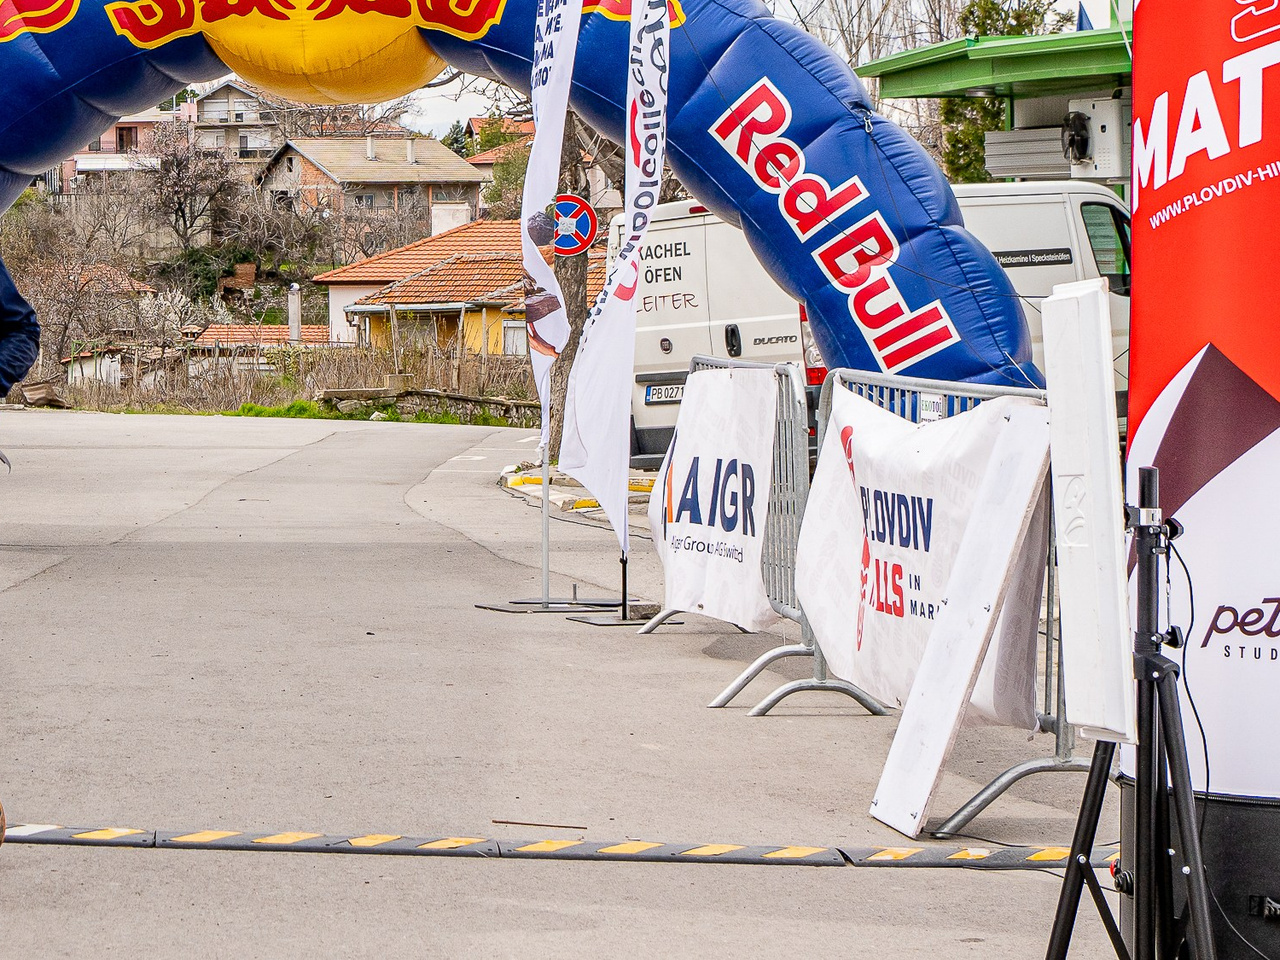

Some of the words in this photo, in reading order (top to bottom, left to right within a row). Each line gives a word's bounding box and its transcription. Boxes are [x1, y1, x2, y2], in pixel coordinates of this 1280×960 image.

[1149, 160, 1280, 229] WWW.PLOVDIV-HI
[714, 83, 862, 236] Red
[818, 217, 953, 370] Bull
[644, 266, 682, 284] ÖFEN
[753, 335, 798, 346] DUCATO
[651, 387, 663, 399] PB
[909, 573, 920, 591] IN
[910, 599, 940, 620] MAR
[1224, 644, 1278, 661] STUD
